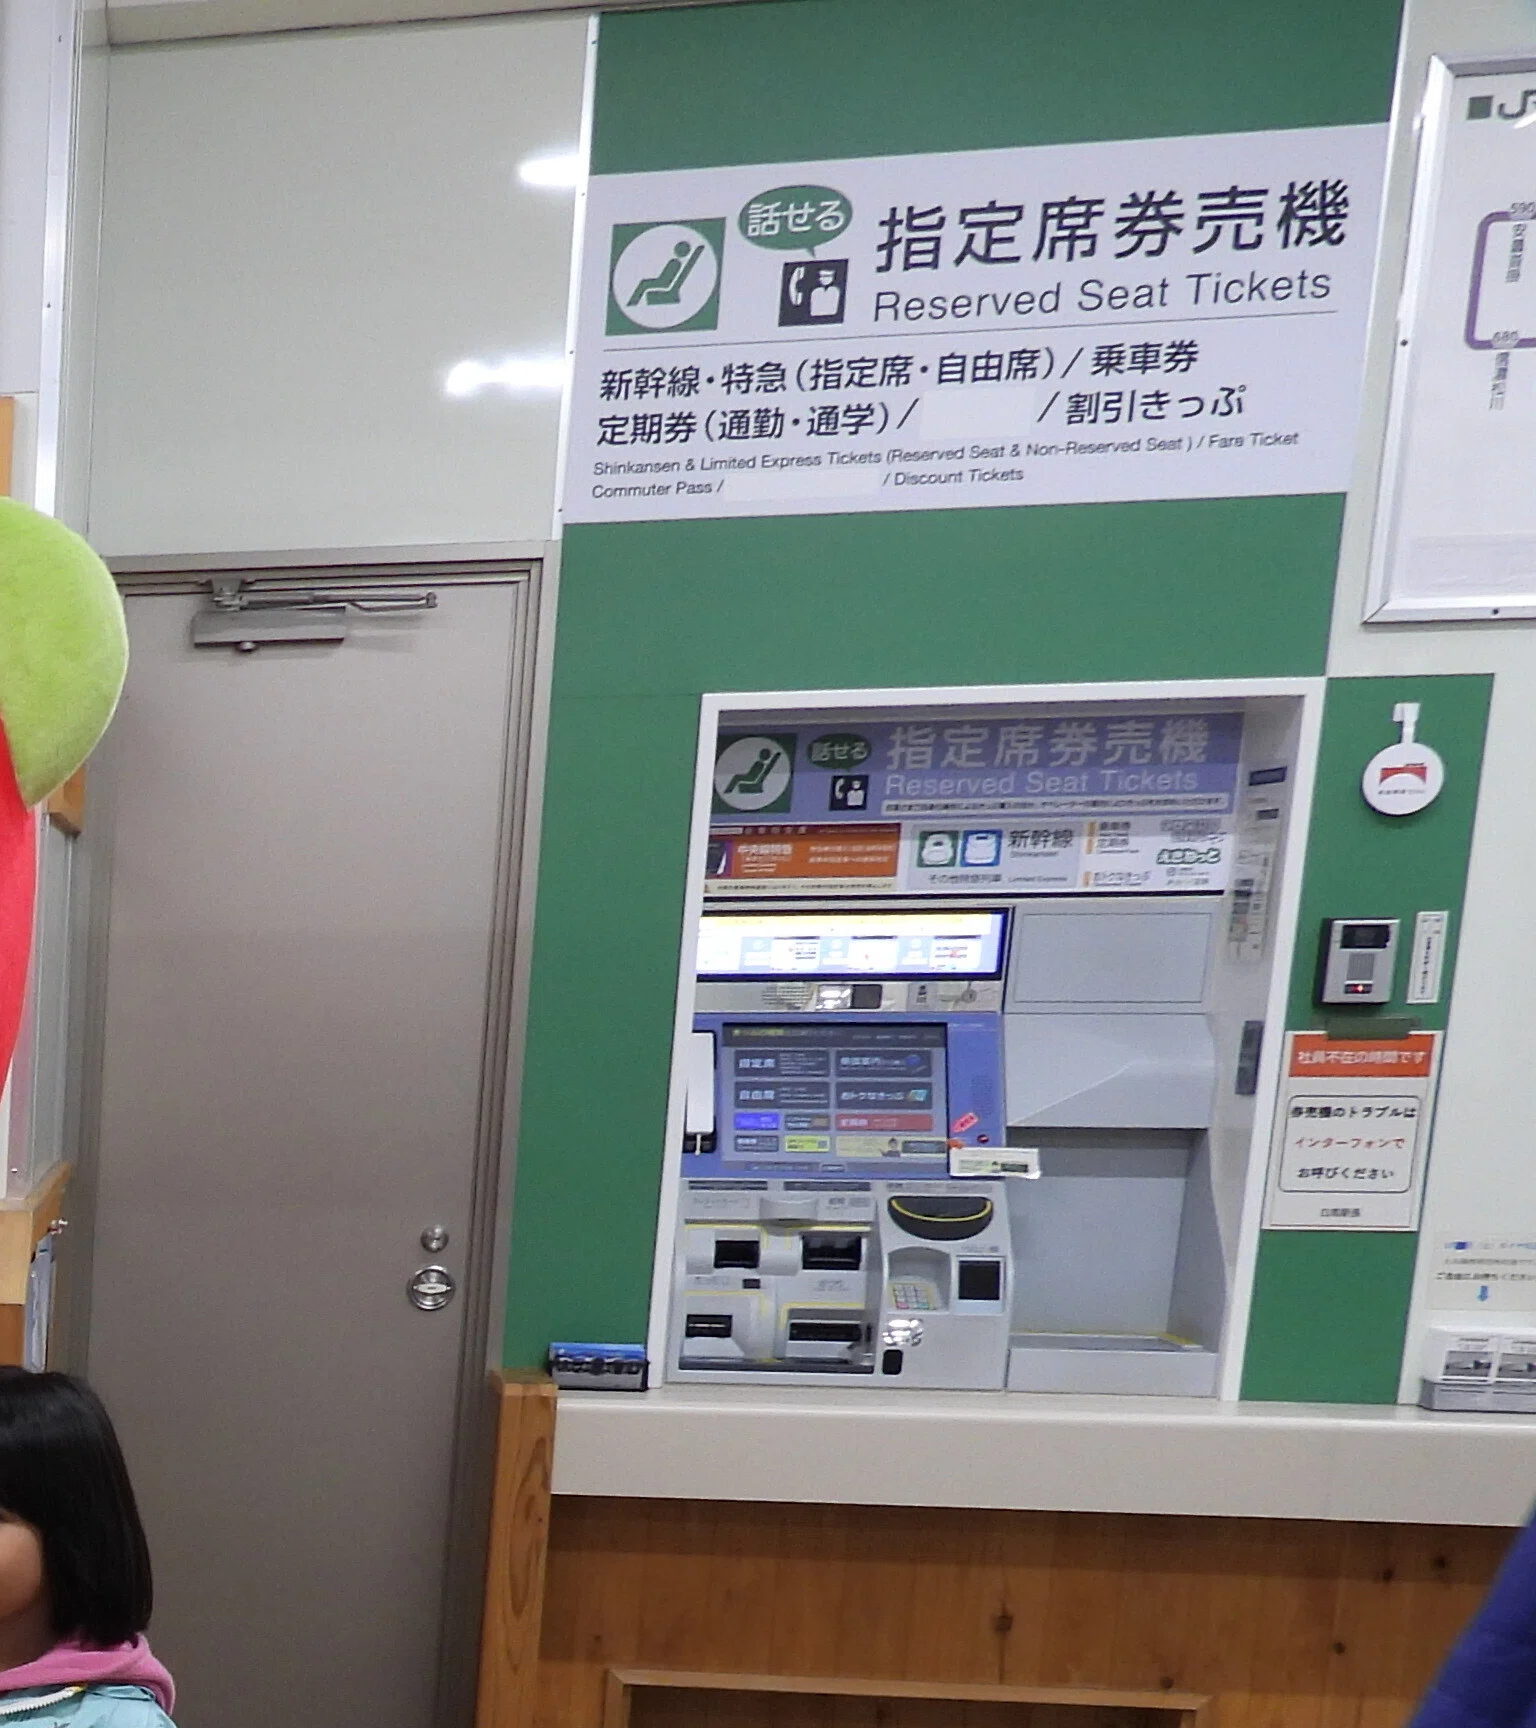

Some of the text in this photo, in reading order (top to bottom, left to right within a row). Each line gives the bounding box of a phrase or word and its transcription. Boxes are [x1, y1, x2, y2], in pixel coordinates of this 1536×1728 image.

[746, 200, 845, 237] 話せる
[875, 178, 1349, 273] 指定席券売機
[873, 268, 1332, 322] Reserved Seat Tickets
[593, 459, 680, 476] Shinkansen
[685, 458, 695, 472] &
[700, 455, 756, 471] Limited
[761, 452, 822, 470] Express
[827, 449, 882, 466] Tickets
[886, 446, 964, 465] (Reserved
[969, 443, 1004, 460] Seat
[1012, 444, 1021, 457] &
[1026, 438, 1142, 457] Non-Reserved
[1208, 433, 1245, 450] Fare
[1249, 430, 1300, 447] Ticket
[894, 469, 963, 487] Discount
[968, 467, 1024, 484] Tickets
[592, 482, 671, 500] Commuter
[676, 481, 713, 496] Pass
[810, 741, 869, 762] 話せる
[886, 718, 1210, 771] 指定席券売機
[885, 768, 1199, 797] Reserved Seat Tickets
[1008, 828, 1073, 850] 新幹線
[1290, 1105, 1417, 1119] 券売機のトラブルは
[1294, 1137, 1406, 1150] インターフォンで
[1296, 1166, 1395, 1181] お呼びください
